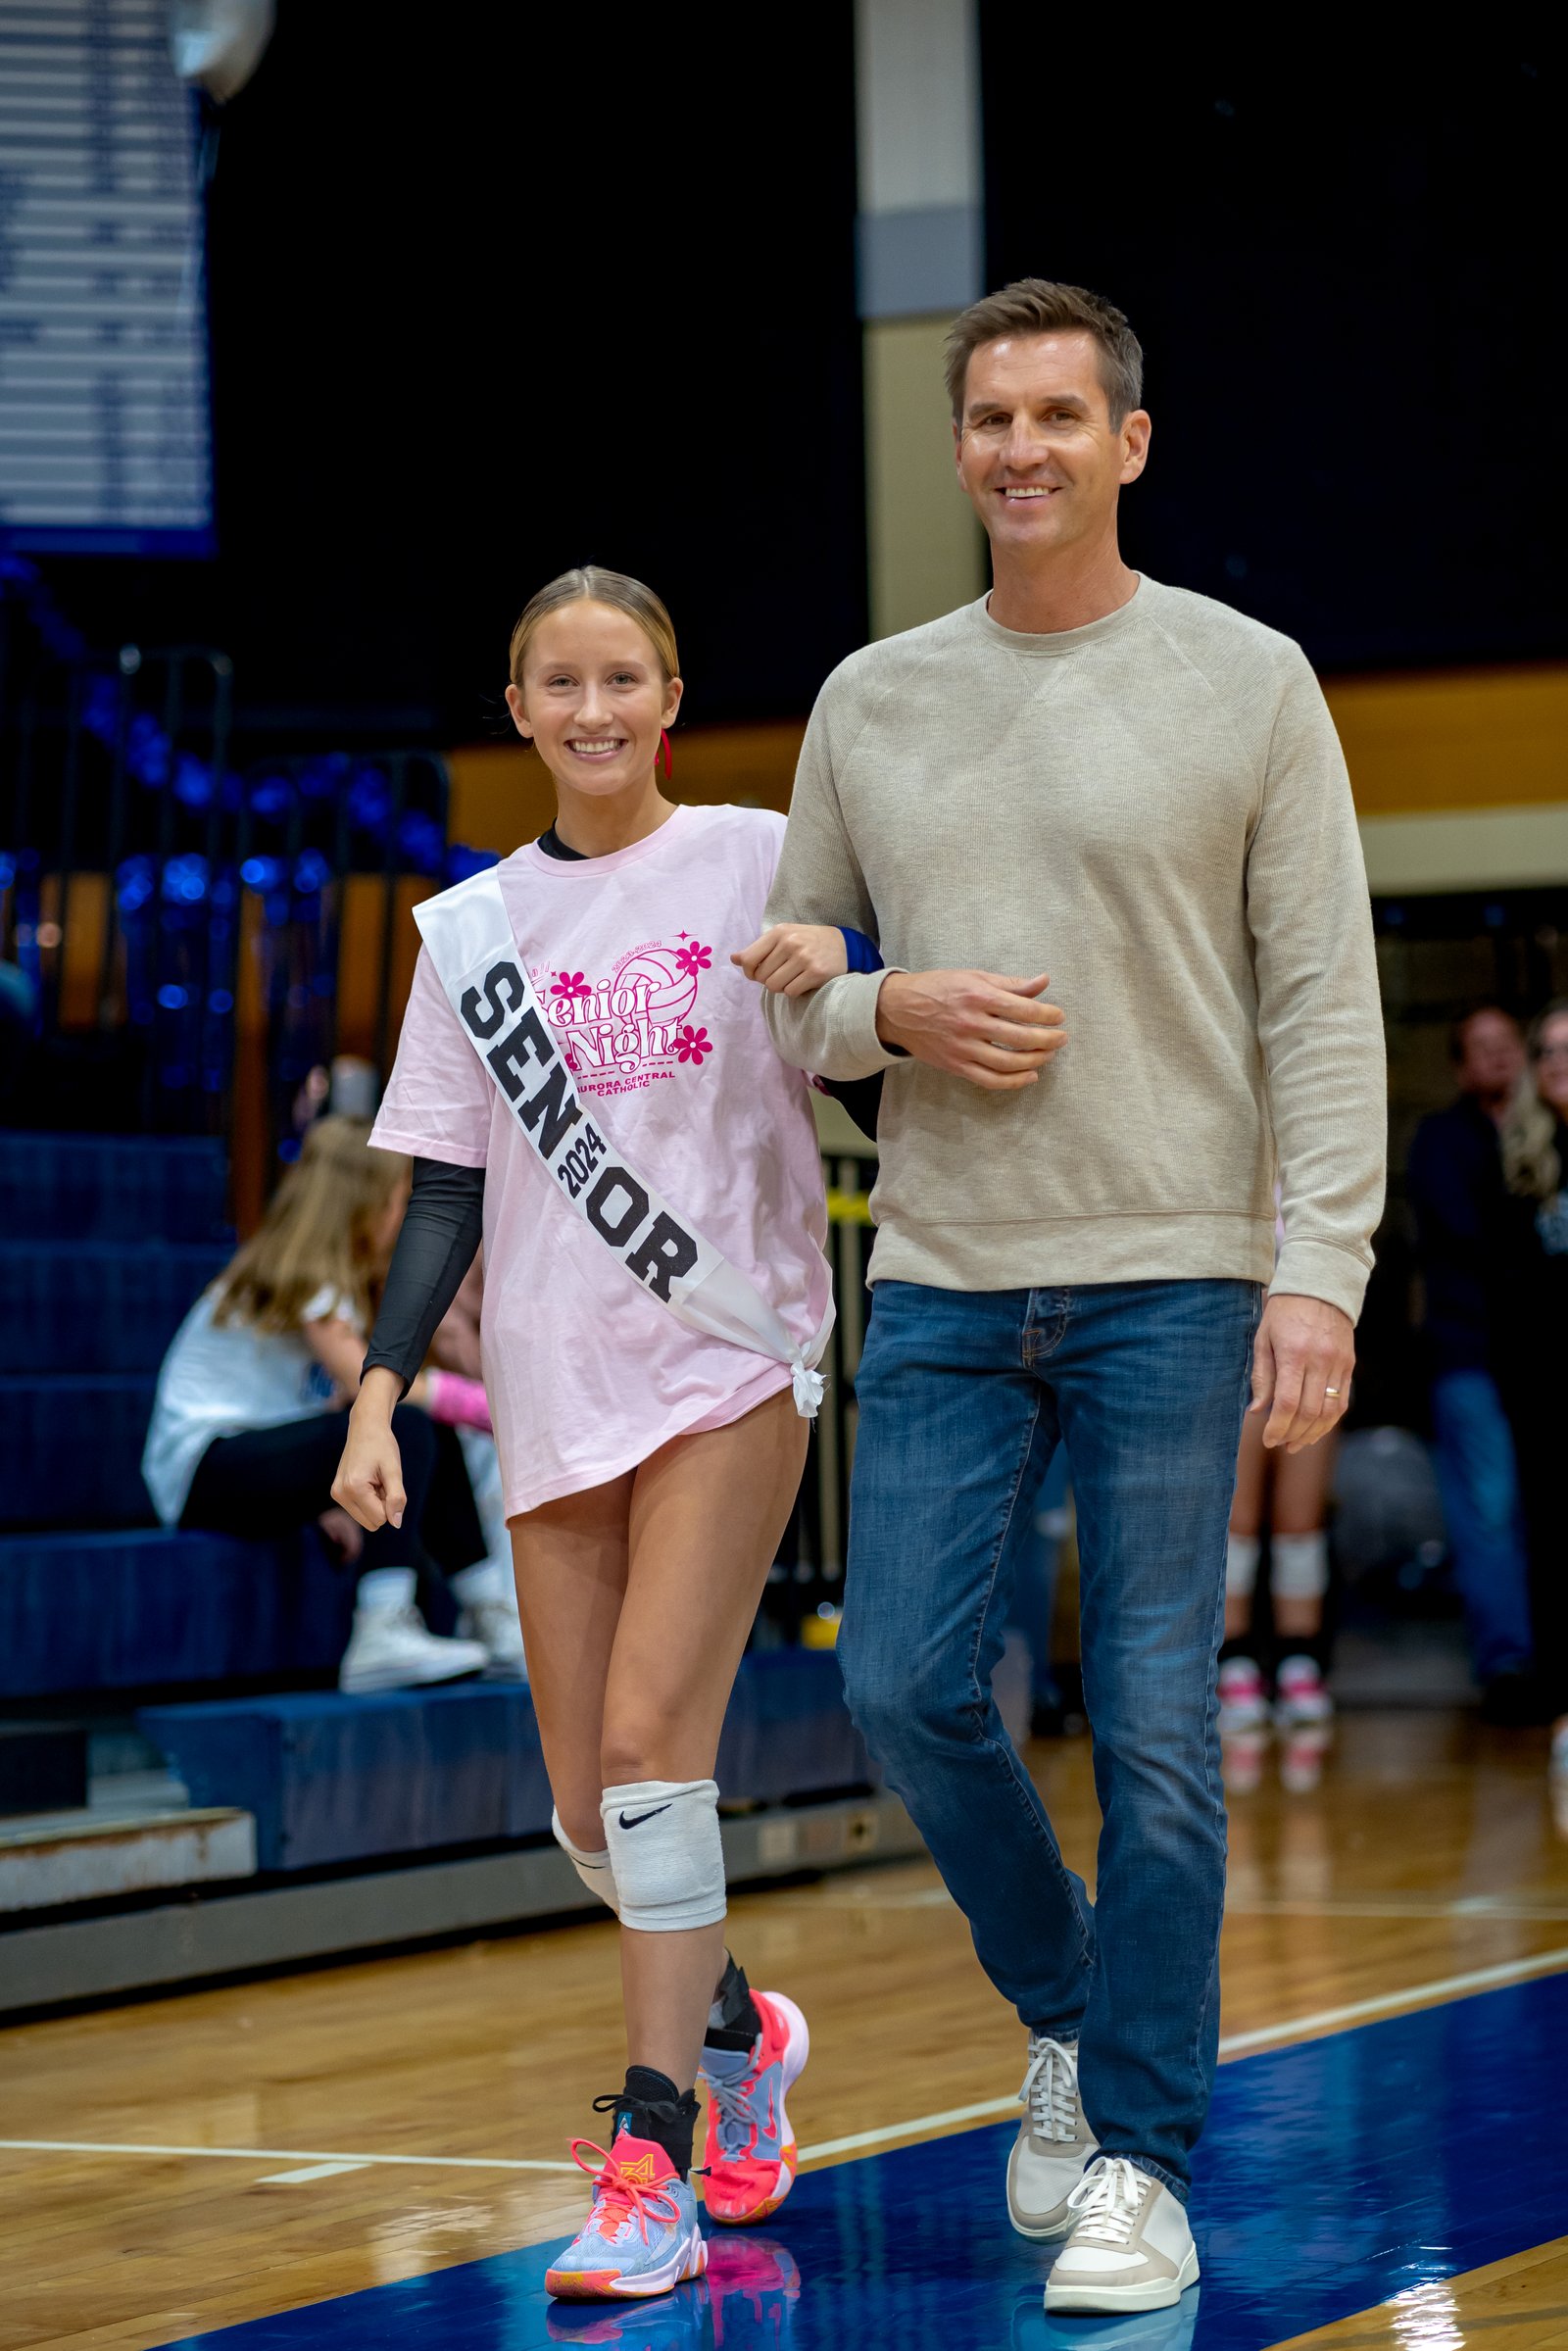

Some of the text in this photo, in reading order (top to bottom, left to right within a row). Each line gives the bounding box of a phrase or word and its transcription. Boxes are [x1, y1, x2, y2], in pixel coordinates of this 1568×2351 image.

[565, 1016, 683, 1075] Night
[624, 1071, 676, 1086] CENTRAL
[597, 1081, 651, 1097] CATHOLIC
